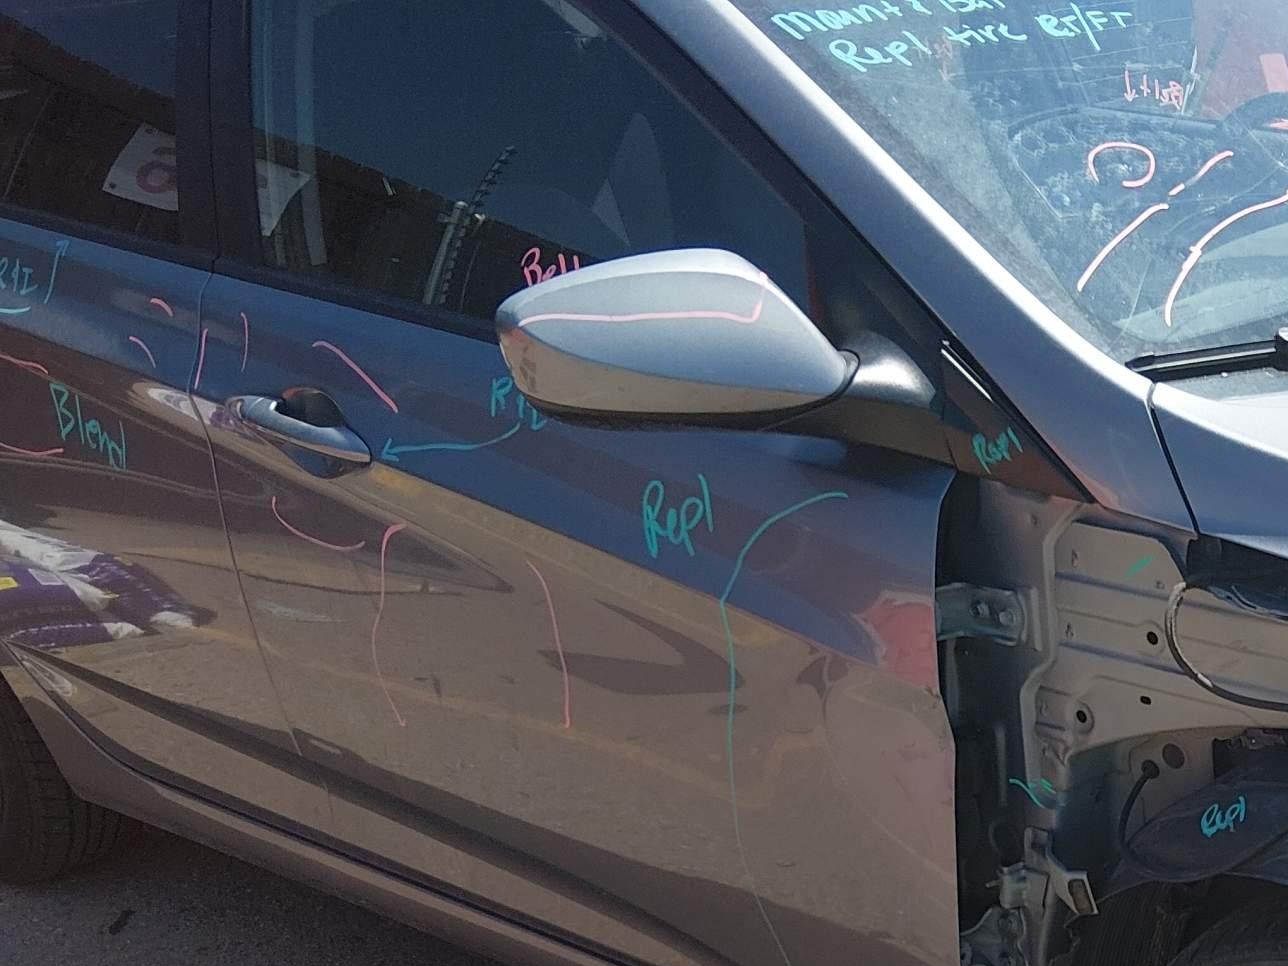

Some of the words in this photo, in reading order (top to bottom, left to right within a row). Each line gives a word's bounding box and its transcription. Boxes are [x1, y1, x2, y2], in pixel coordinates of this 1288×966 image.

[828, 30, 932, 73] Repl
[943, 23, 1028, 46] tire
[49, 382, 128, 472] Blend
[642, 473, 714, 559] Repl
